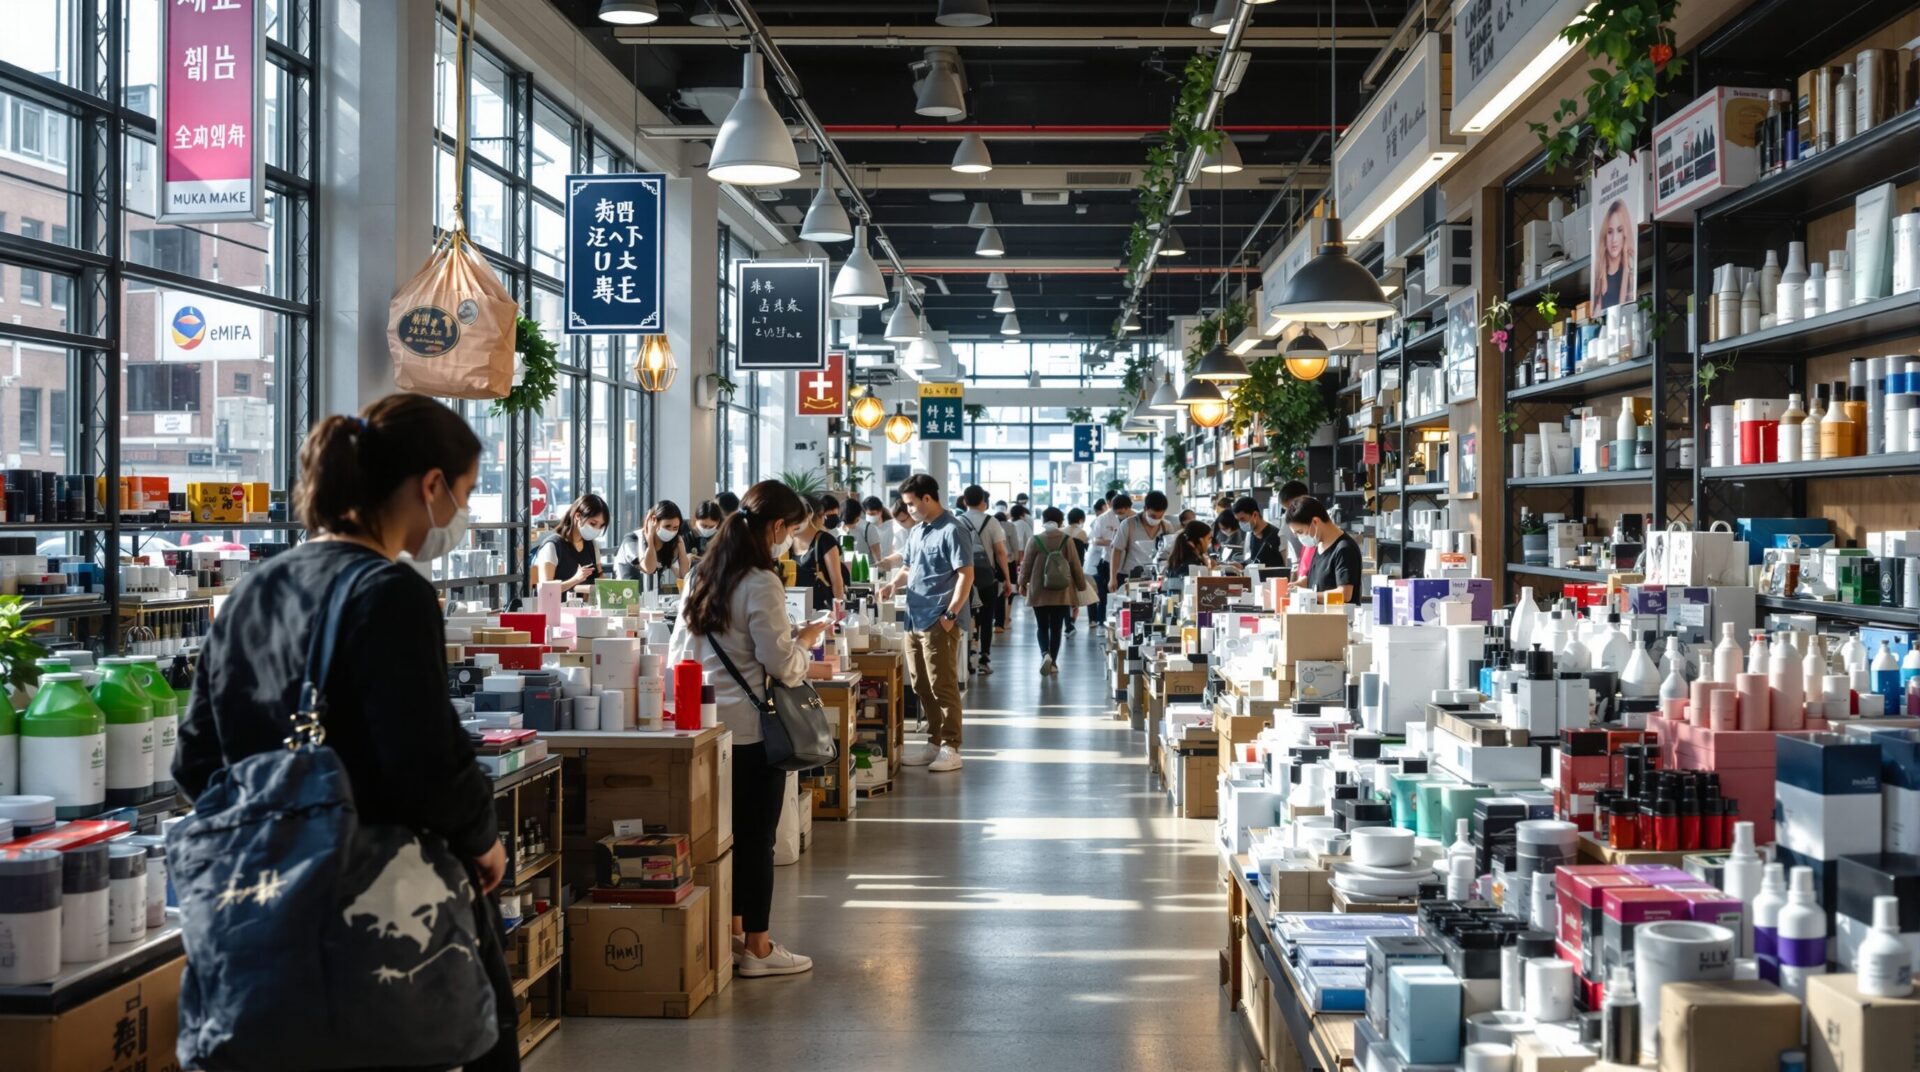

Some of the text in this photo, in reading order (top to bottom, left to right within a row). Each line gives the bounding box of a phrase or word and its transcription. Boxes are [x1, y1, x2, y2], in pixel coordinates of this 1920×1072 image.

[173, 191, 246, 205] MUKA MAKE
[210, 325, 252, 341] eMIFA
